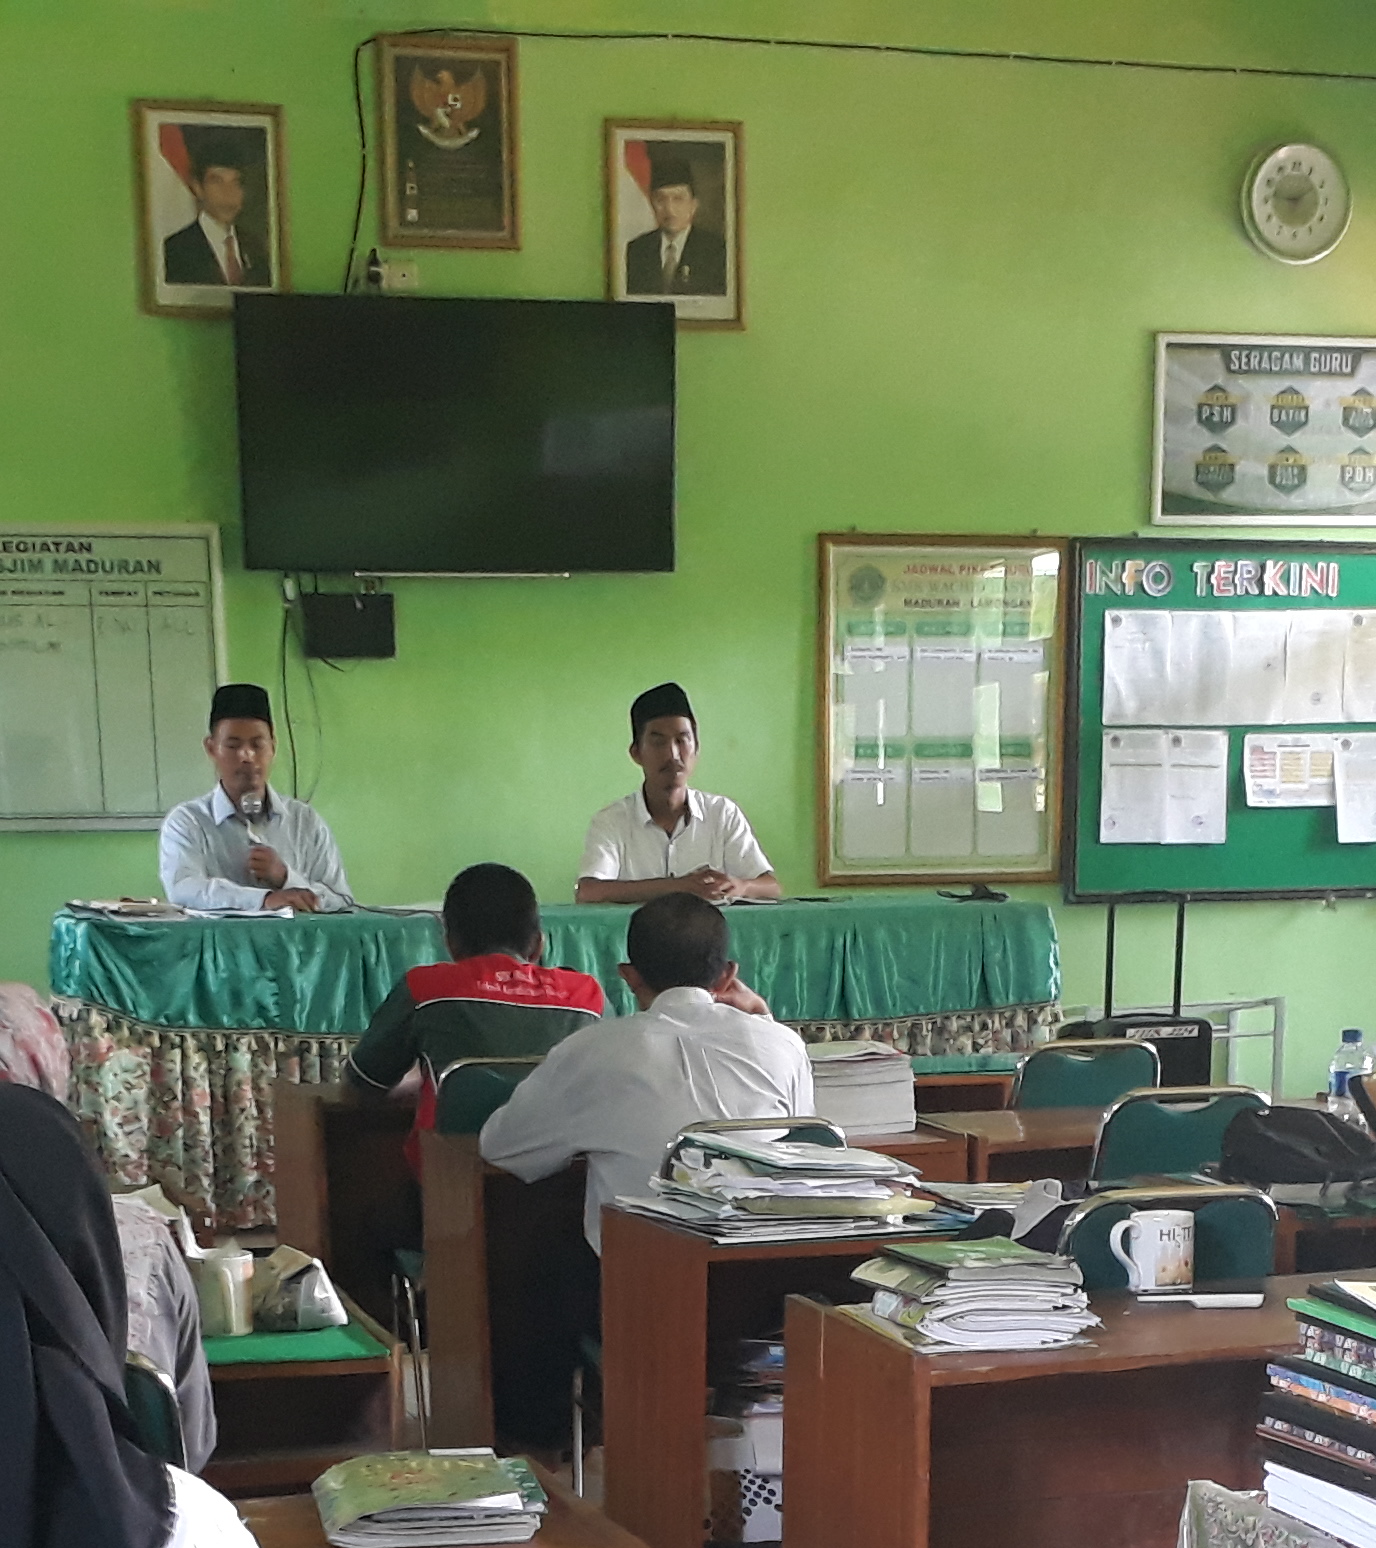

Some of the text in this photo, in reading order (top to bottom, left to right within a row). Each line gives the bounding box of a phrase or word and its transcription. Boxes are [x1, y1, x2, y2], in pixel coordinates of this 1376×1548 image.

[1229, 350, 1354, 374] SERAGAM GURU
[51, 557, 162, 576] MADURAN
[1085, 559, 1340, 599] INFO TERKINI
